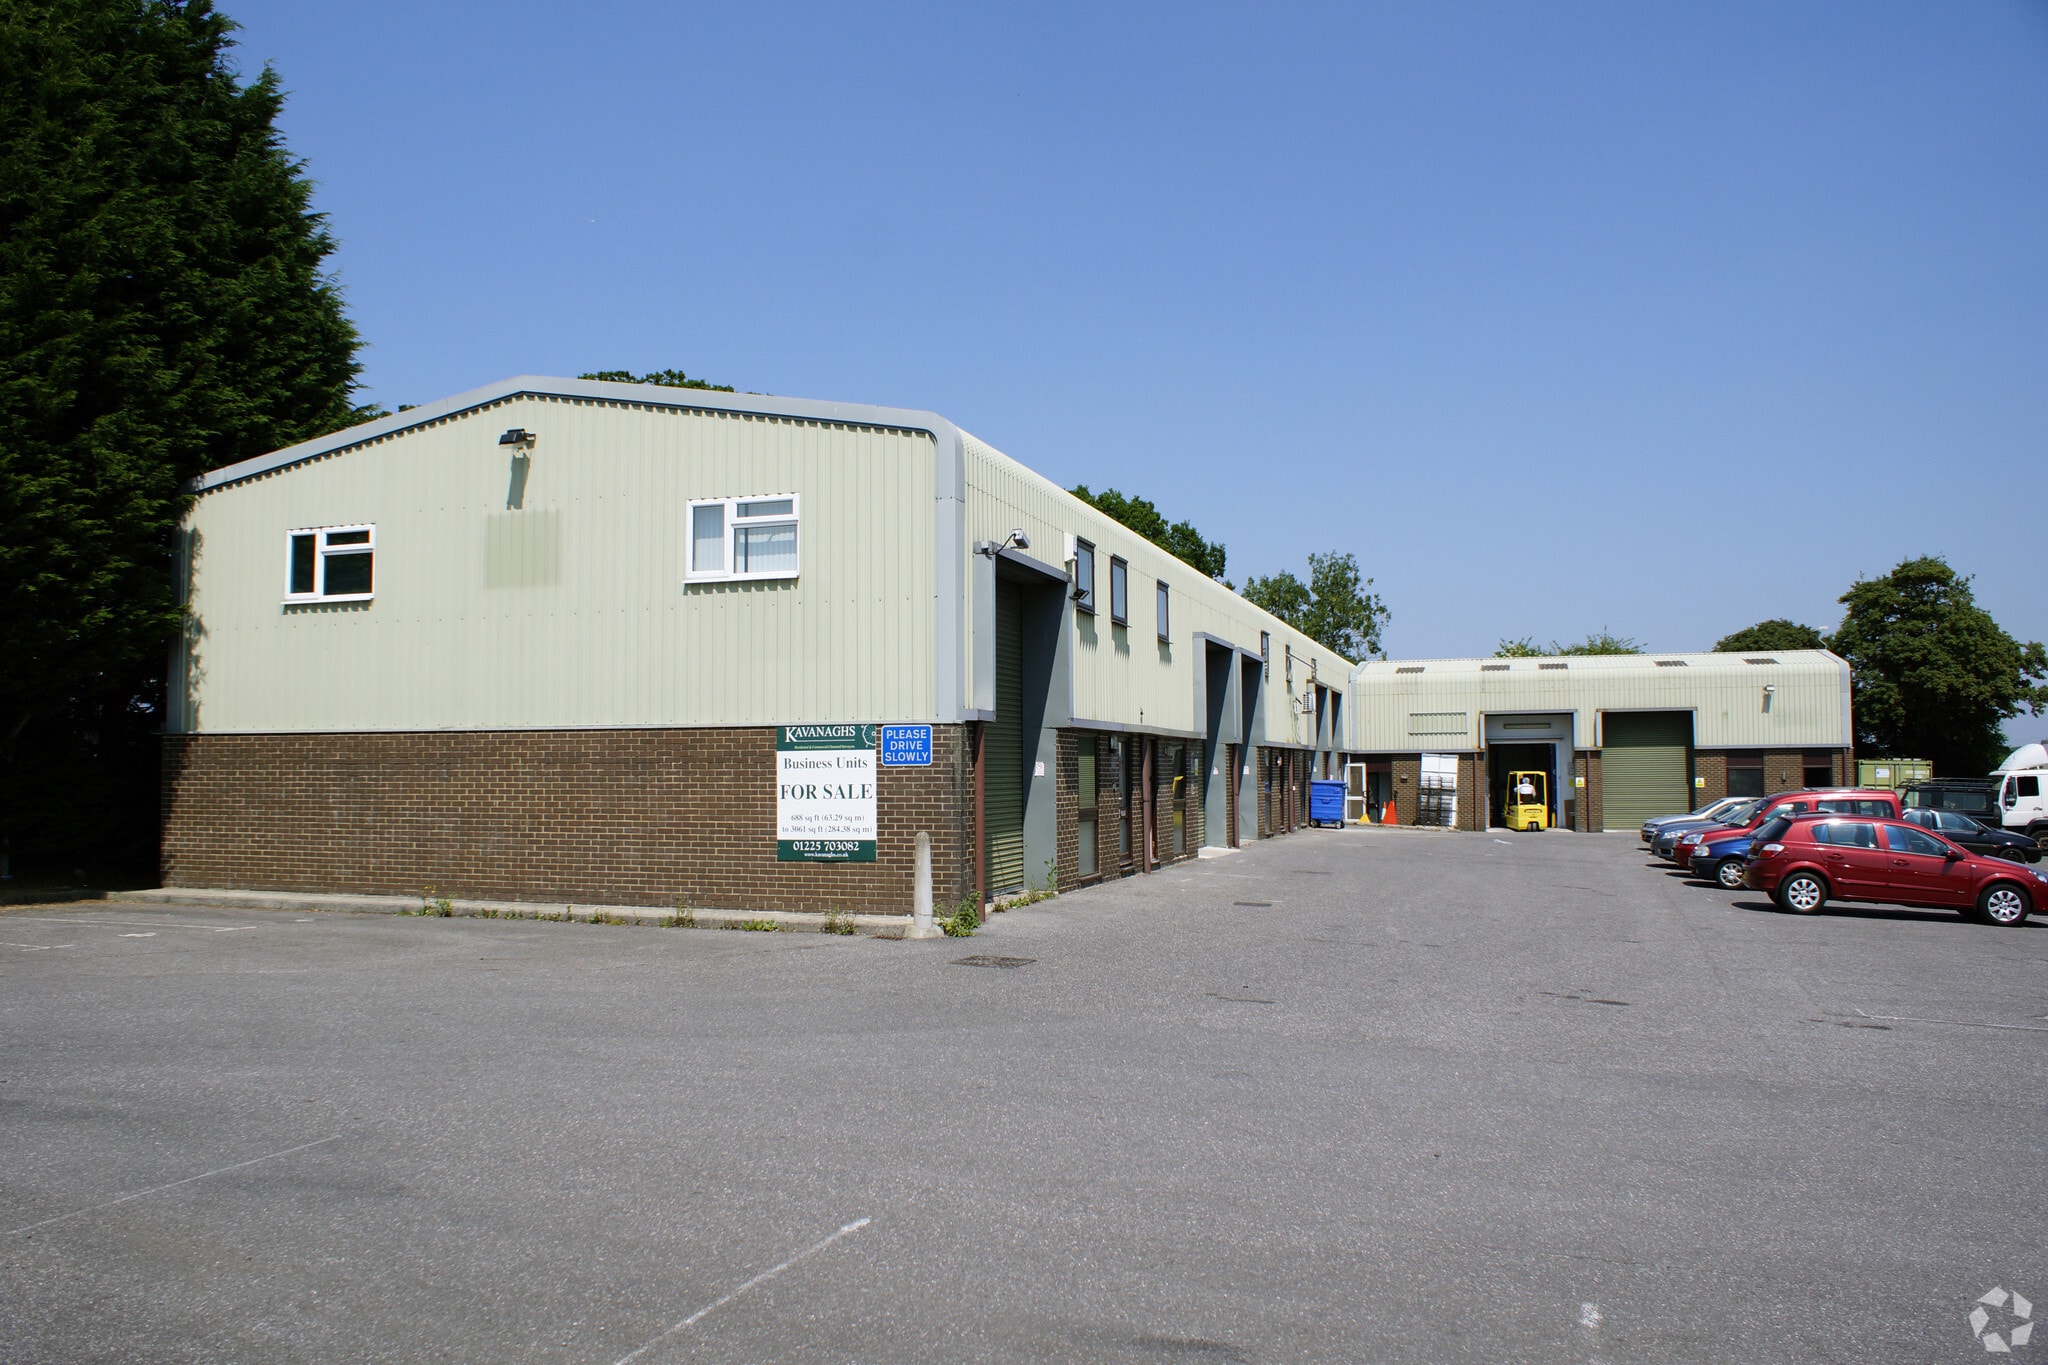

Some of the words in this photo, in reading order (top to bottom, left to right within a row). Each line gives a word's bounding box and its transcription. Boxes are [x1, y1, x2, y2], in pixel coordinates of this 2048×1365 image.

[785, 726, 856, 743] KAVANAGHS
[886, 729, 927, 739] PLEASE
[890, 740, 923, 750] DRIVE
[885, 752, 928, 762] SLOWLY
[784, 757, 833, 769] Business
[836, 757, 868, 769] Units
[780, 784, 818, 799] FOR
[823, 783, 873, 799] SALE
[805, 815, 813, 823] sq
[821, 814, 843, 822] (63.29
[854, 814, 865, 822] m)
[790, 825, 806, 833] 3061
[817, 825, 823, 833] ft
[792, 841, 821, 851] 01225
[823, 841, 860, 851] 703082
